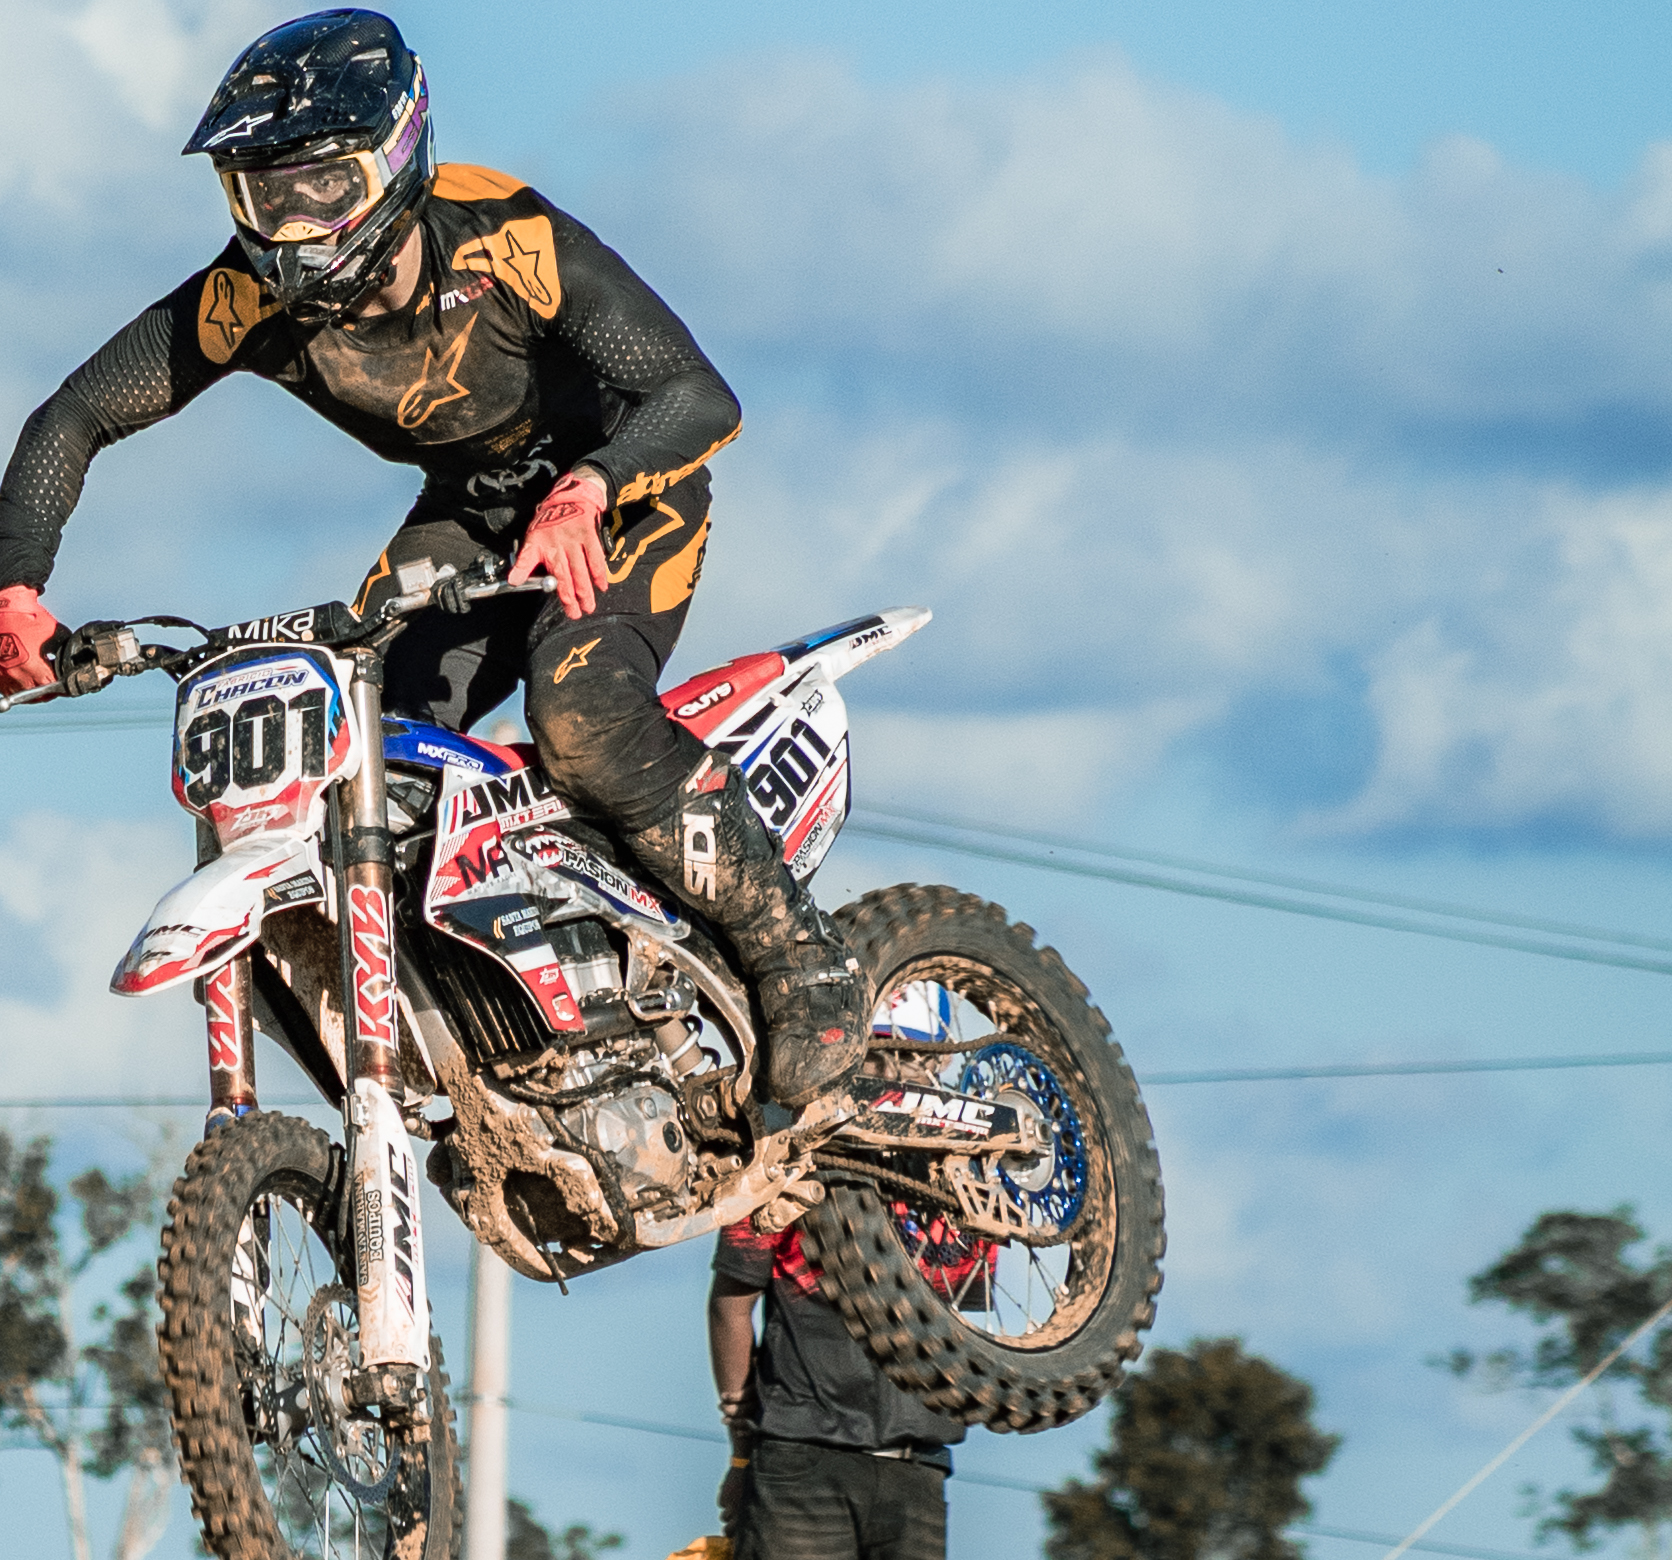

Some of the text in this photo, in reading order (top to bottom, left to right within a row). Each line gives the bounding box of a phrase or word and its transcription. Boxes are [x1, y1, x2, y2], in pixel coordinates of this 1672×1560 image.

[183, 687, 326, 809] 901
[677, 682, 732, 717] GUTS
[747, 718, 832, 827] 901
[205, 962, 242, 1072] YB
[349, 885, 392, 1042] KYB
[876, 1092, 996, 1129] JMC
[368, 1190, 383, 1263] EQUIPOS
[388, 1142, 415, 1315] JMC
